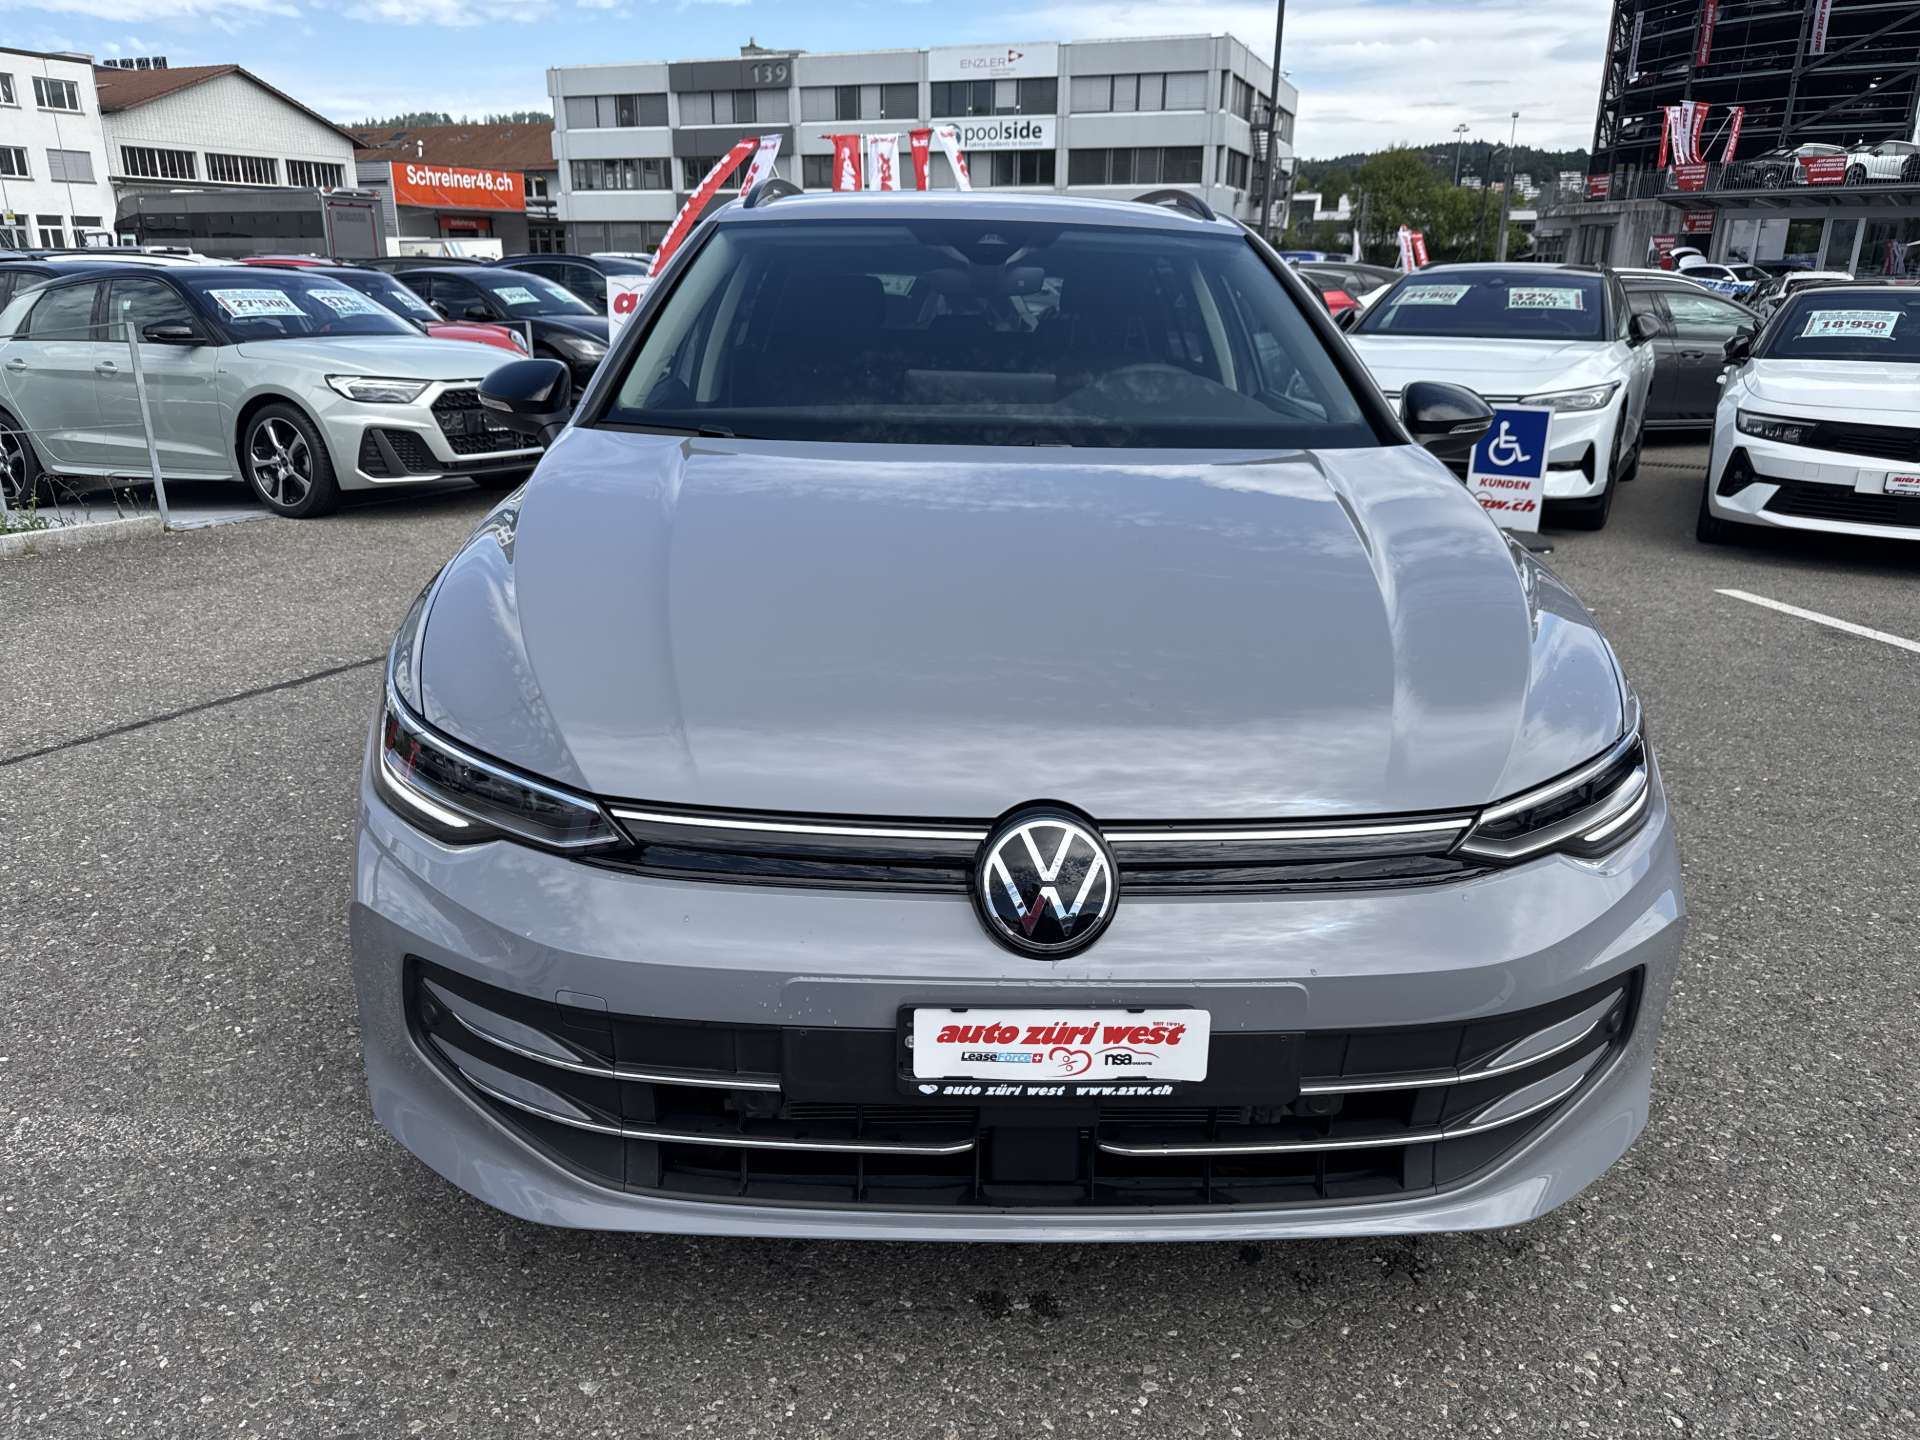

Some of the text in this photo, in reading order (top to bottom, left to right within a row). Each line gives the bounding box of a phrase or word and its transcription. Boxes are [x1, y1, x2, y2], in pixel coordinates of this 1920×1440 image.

[960, 57, 1006, 69] ENZLER
[754, 64, 787, 83] 139
[965, 120, 1042, 147] poolside
[406, 165, 514, 192] Schreiner48.ch
[1512, 293, 1557, 301] 32%
[1822, 320, 1888, 330] 18'950
[1480, 478, 1531, 490] KUNDEN
[936, 1021, 1187, 1046] auto züri west
[961, 1052, 1032, 1063] LeaseForce
[1105, 1054, 1132, 1066] nsa
[943, 1084, 1174, 1096] auto züri west www.azw.ch
